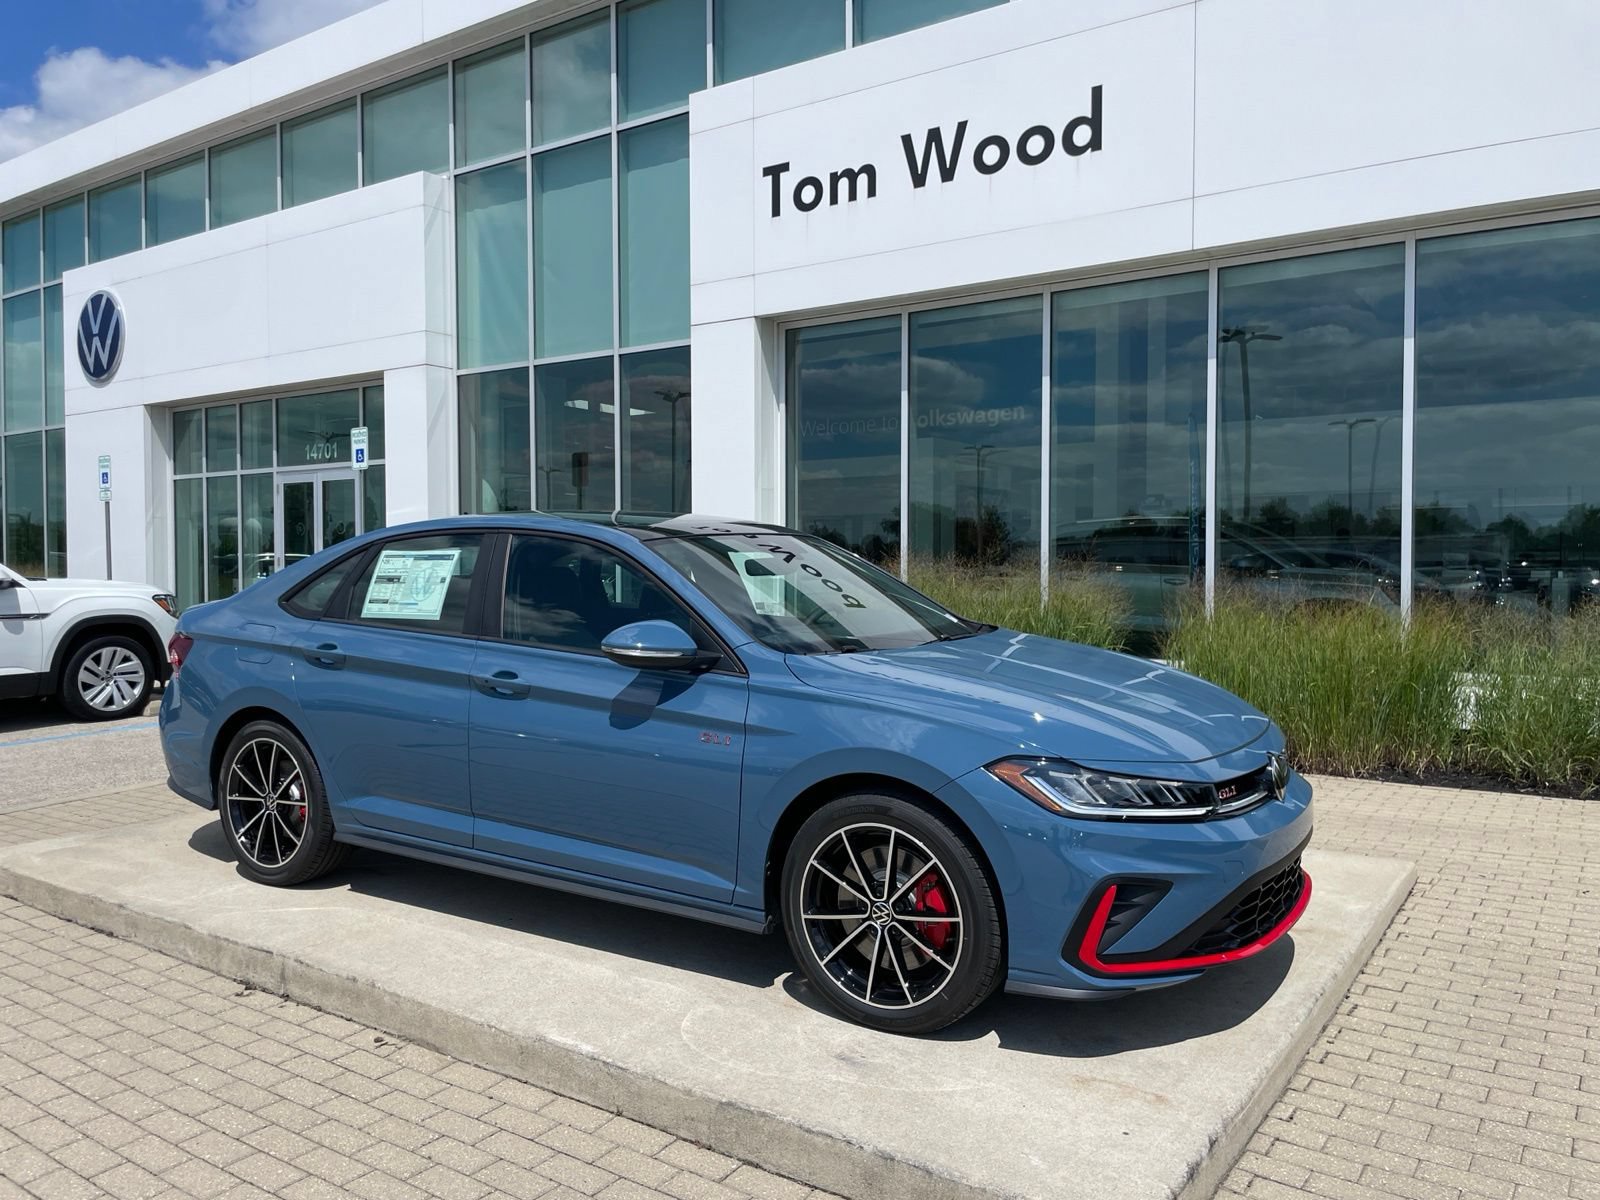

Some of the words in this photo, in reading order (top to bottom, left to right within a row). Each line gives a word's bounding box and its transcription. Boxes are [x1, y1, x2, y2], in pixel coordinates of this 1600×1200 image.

[762, 161, 877, 218] Tom
[900, 84, 1103, 189] Wood
[800, 416, 876, 437] Welcome
[917, 405, 1025, 429] olkswagen
[305, 442, 338, 460] 14701
[1218, 785, 1237, 800] GLI
